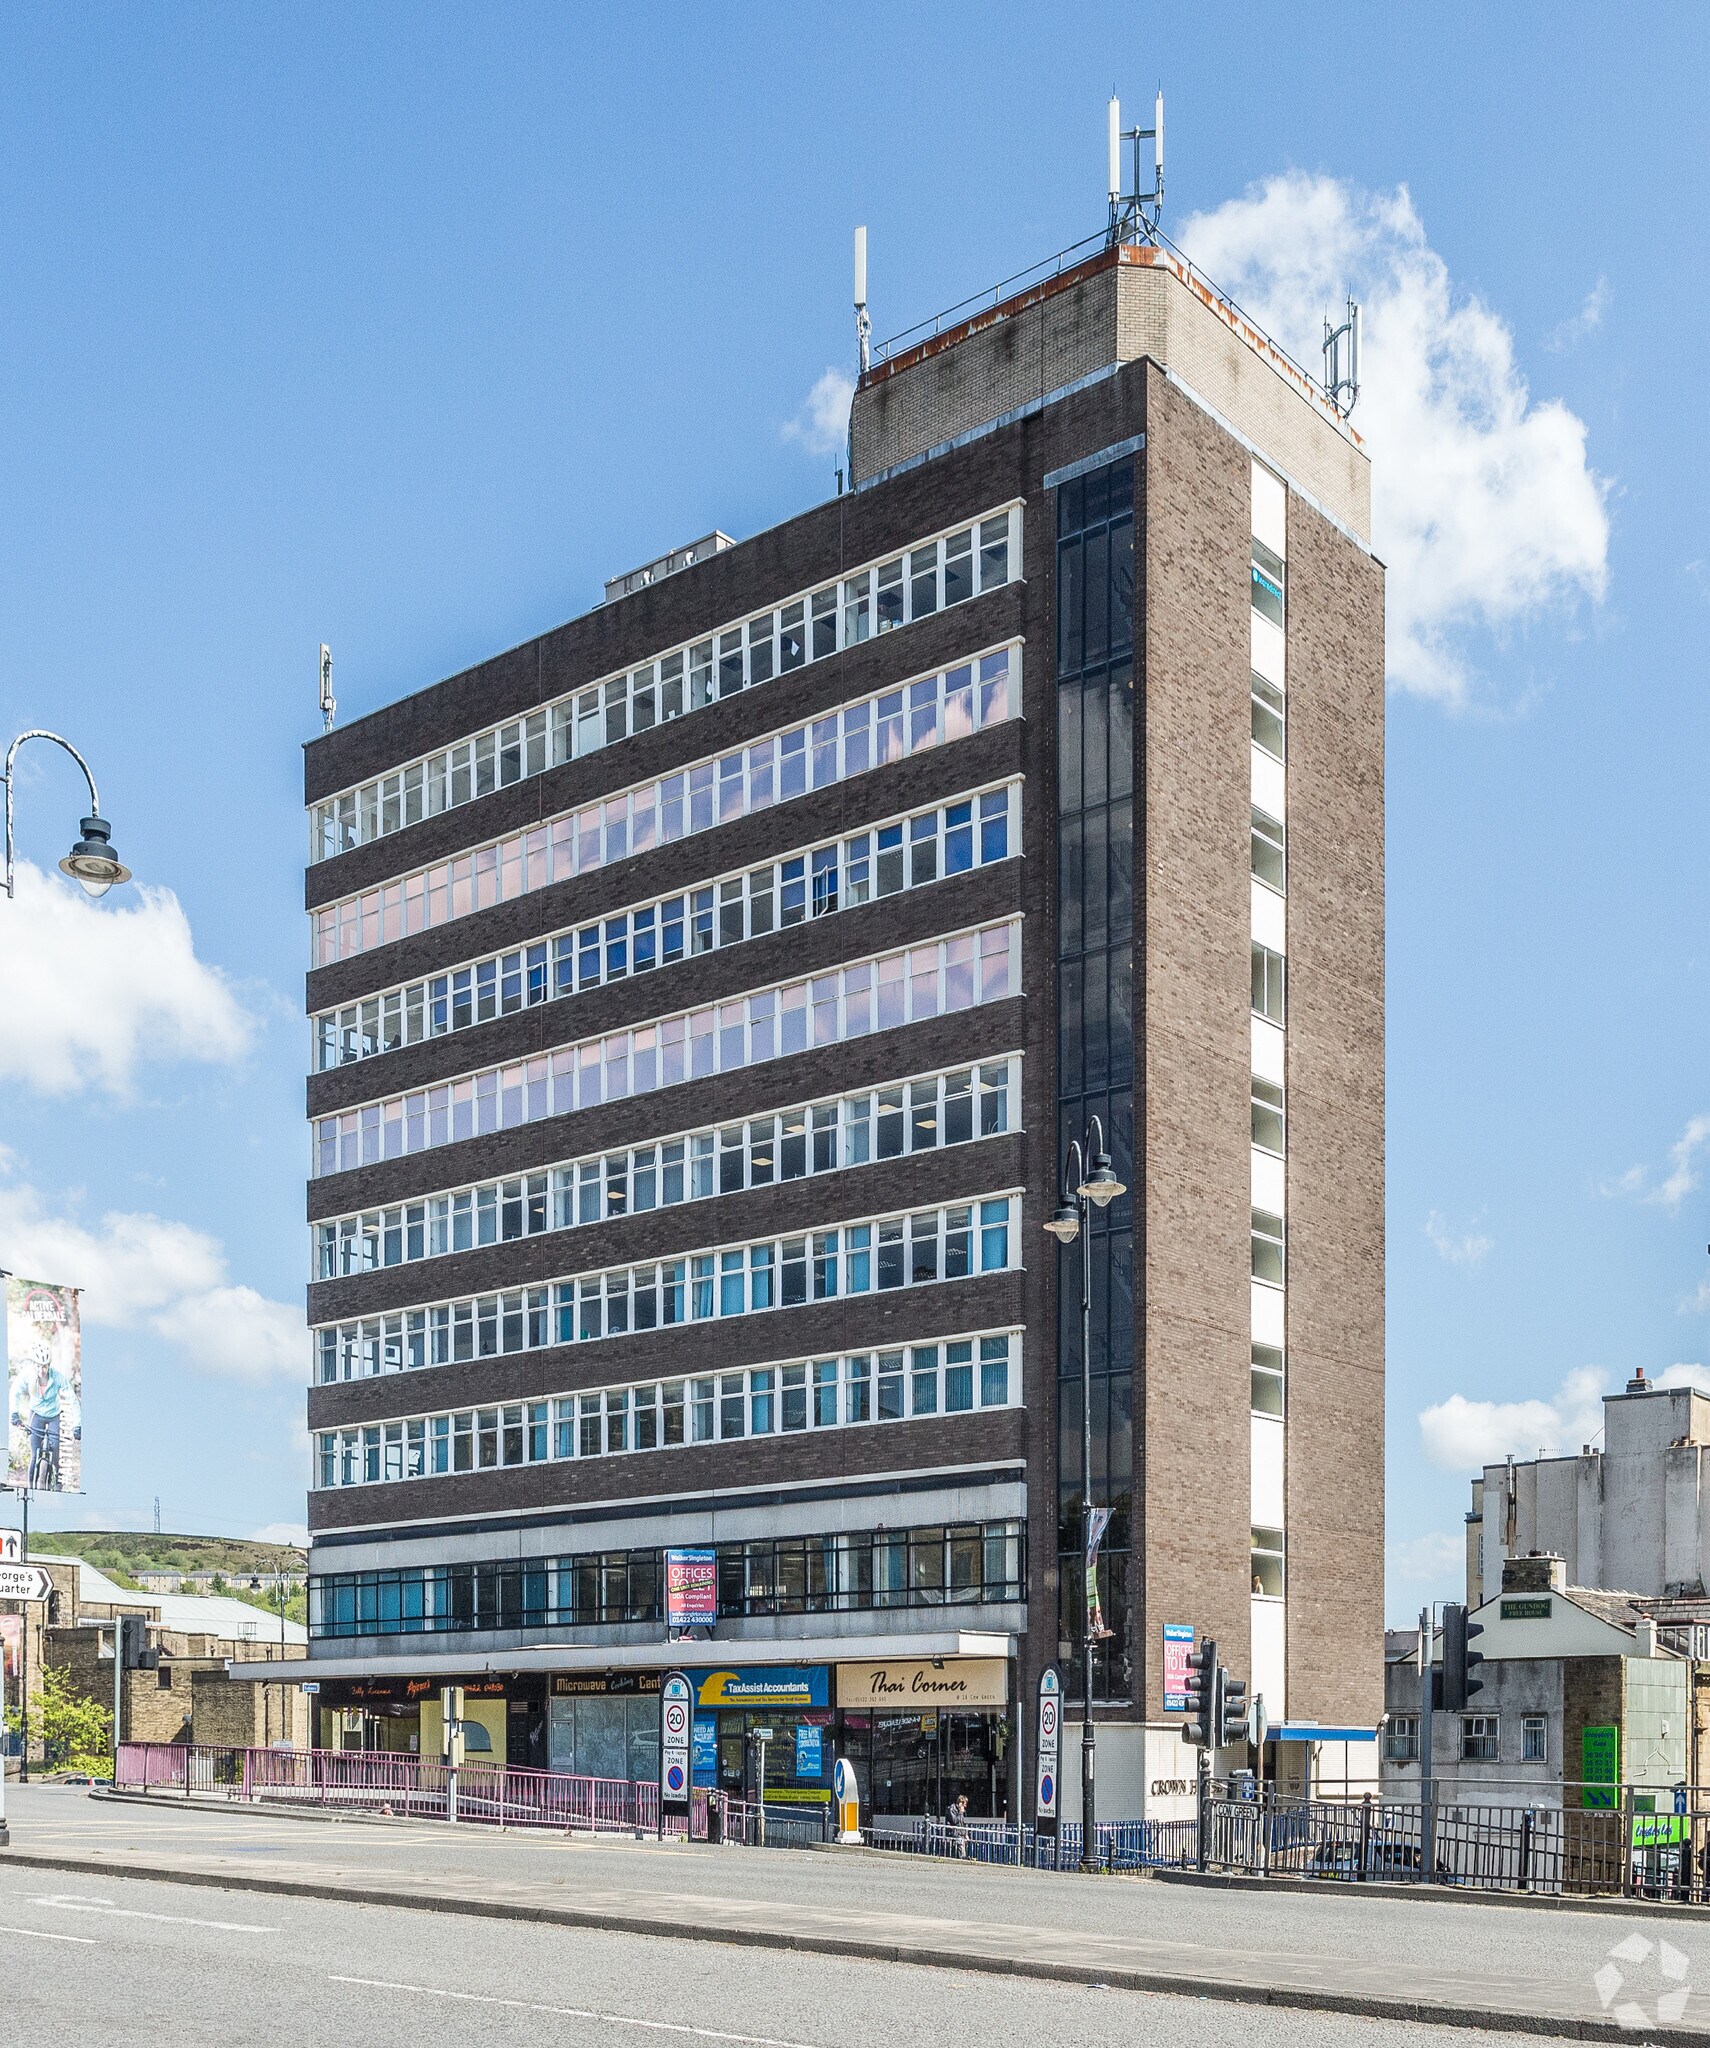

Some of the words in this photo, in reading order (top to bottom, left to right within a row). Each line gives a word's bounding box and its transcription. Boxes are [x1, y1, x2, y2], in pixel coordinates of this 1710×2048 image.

[29, 1300, 55, 1311] ACTIVE
[0, 1571, 33, 1582] orge's
[671, 1567, 713, 1579] OFFICES
[1166, 1656, 1178, 1670] TO
[556, 1678, 606, 1691] Microwave
[869, 1671, 906, 1693] Thai
[911, 1670, 967, 1693] Corner
[763, 1682, 810, 1693] Accountants
[669, 1713, 682, 1725] 20
[1044, 1711, 1054, 1725] 20
[667, 1736, 684, 1744] ZONE
[1042, 1739, 1055, 1748] ZONE
[667, 1757, 684, 1765] ZONE
[1042, 1765, 1054, 1773] ZONE
[1151, 1779, 1187, 1796] CROWN
[671, 1792, 687, 1800] loading
[1218, 1804, 1233, 1817] COW
[1234, 1805, 1255, 1818] GREEN
